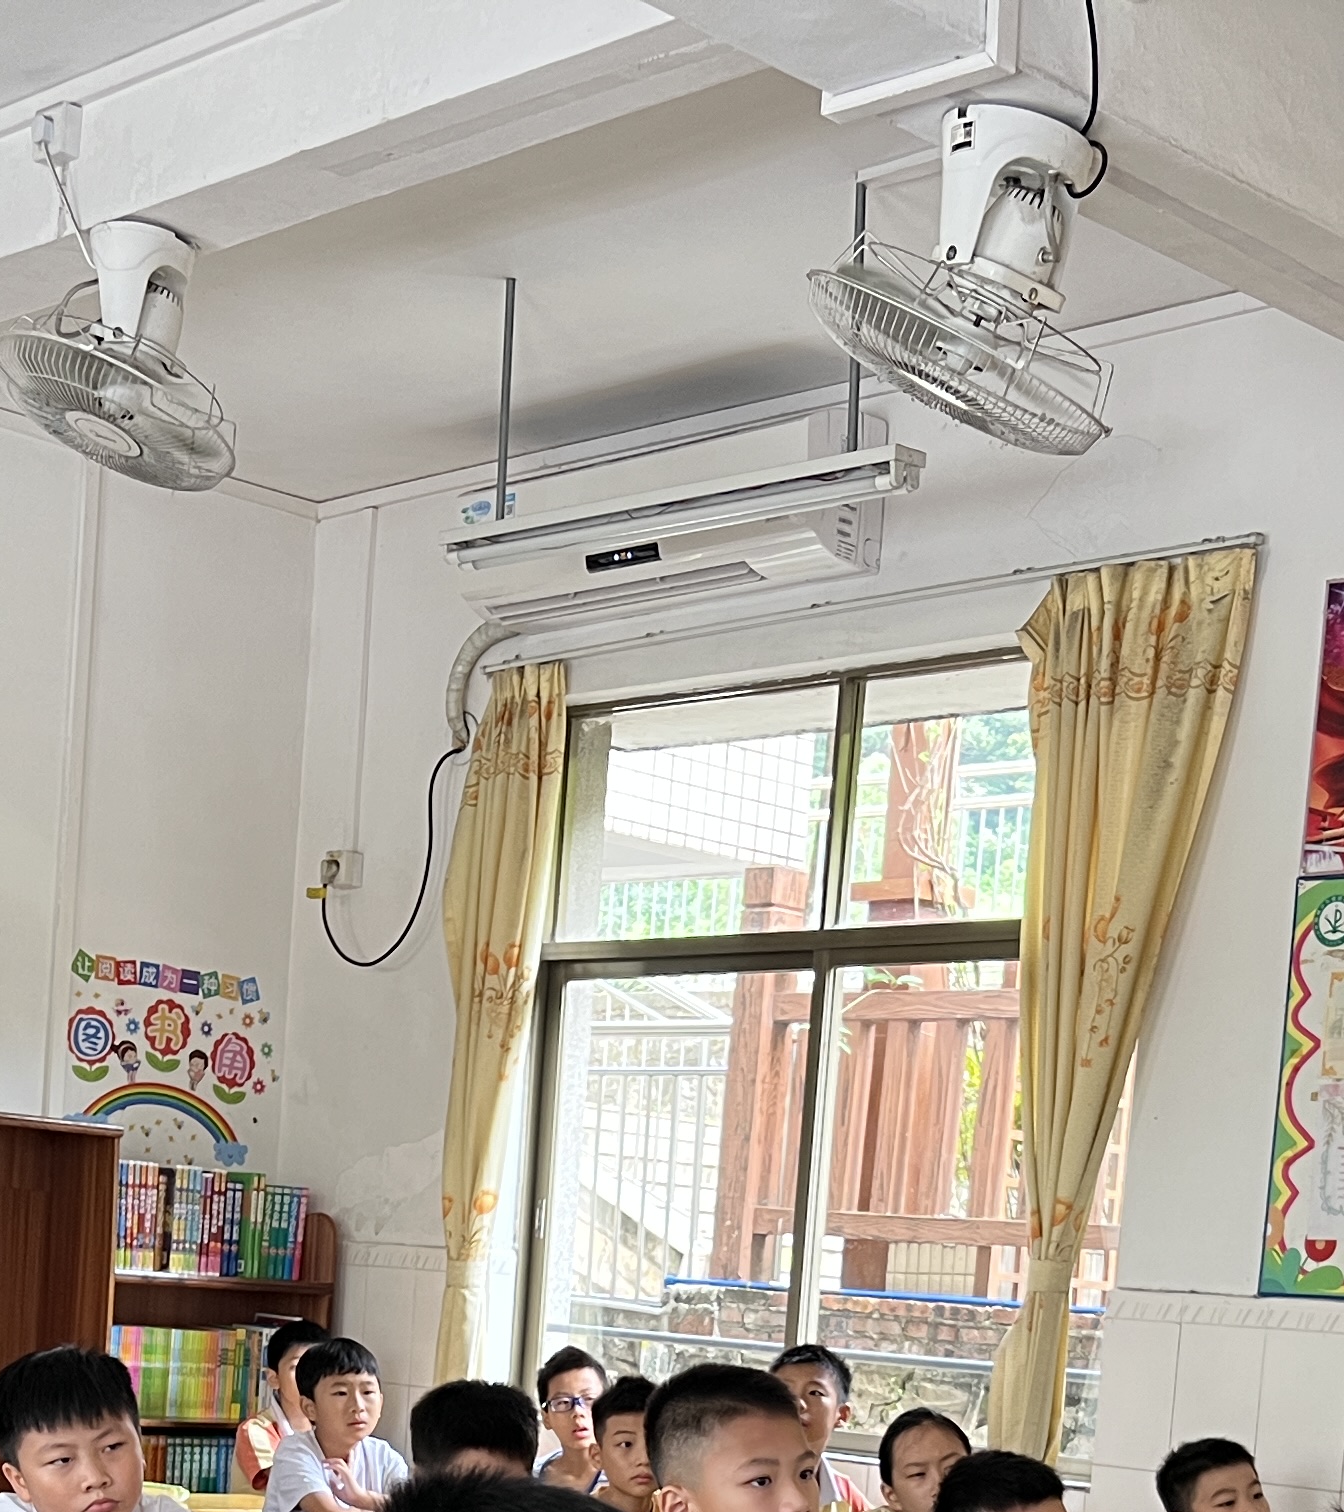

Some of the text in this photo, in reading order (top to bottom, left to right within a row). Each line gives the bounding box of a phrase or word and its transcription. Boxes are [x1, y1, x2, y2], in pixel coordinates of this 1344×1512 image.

[76, 956, 259, 1001] 让阅读成为一种习惯
